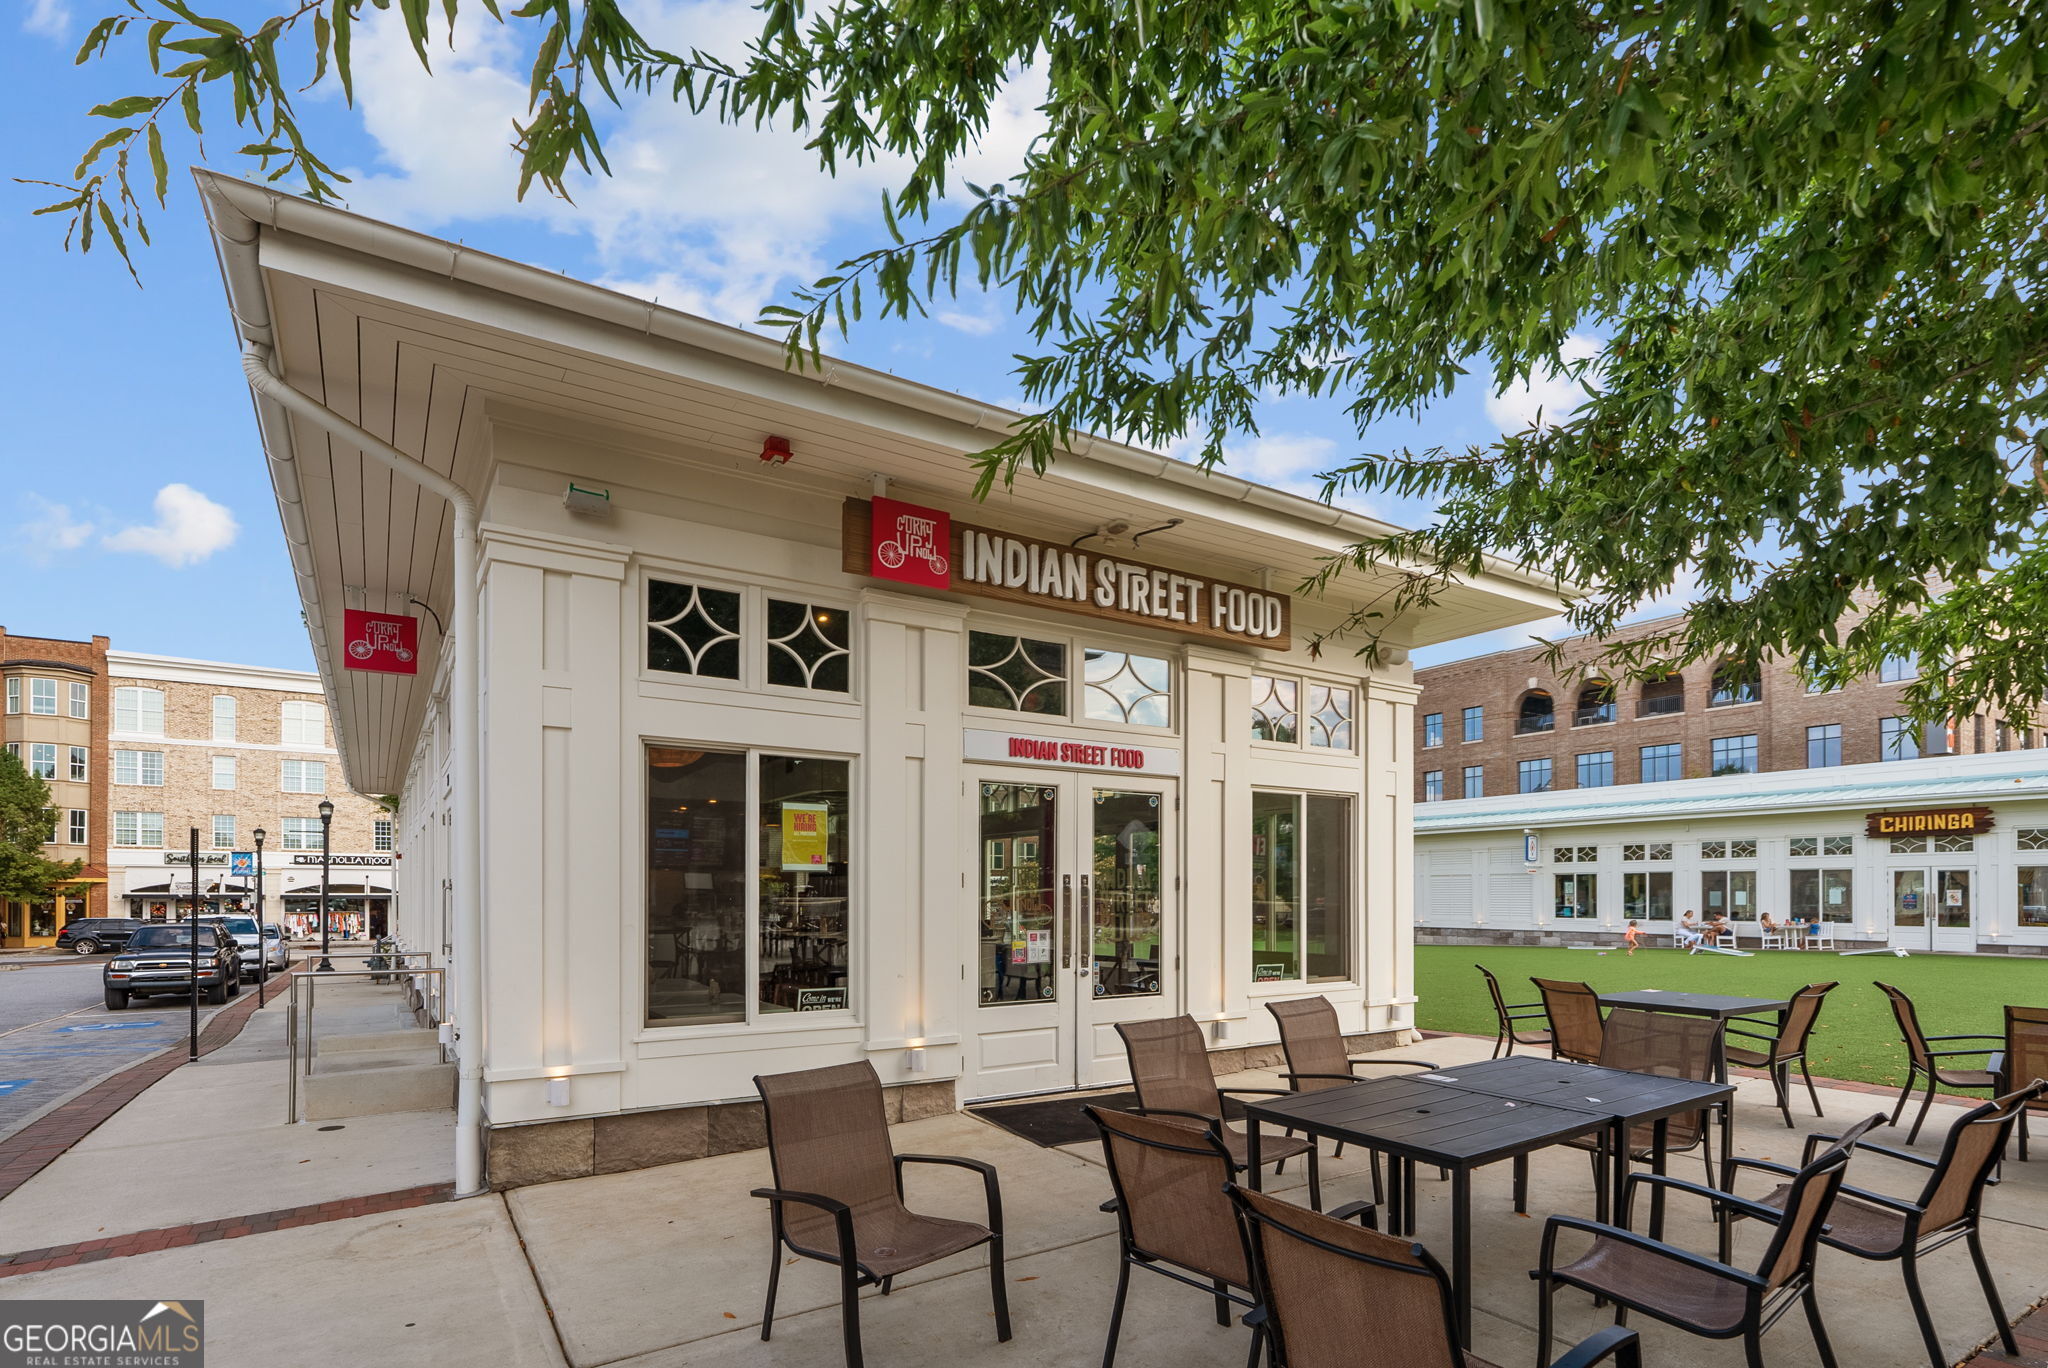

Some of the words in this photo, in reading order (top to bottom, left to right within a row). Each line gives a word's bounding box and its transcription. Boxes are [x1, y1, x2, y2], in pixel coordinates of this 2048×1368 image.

[896, 531, 923, 558] UP
[915, 545, 937, 561] NOW
[962, 530, 1088, 601] INDIAN
[1094, 559, 1204, 624] STREET
[1210, 583, 1282, 639] FOOD
[1008, 737, 1058, 760] INDIAN
[1060, 742, 1107, 766] STREET
[1110, 747, 1145, 769] FOOD
[1880, 813, 1975, 833] CHIRINGA
[166, 853, 206, 864] Southn
[307, 856, 363, 865] MANOLIA
